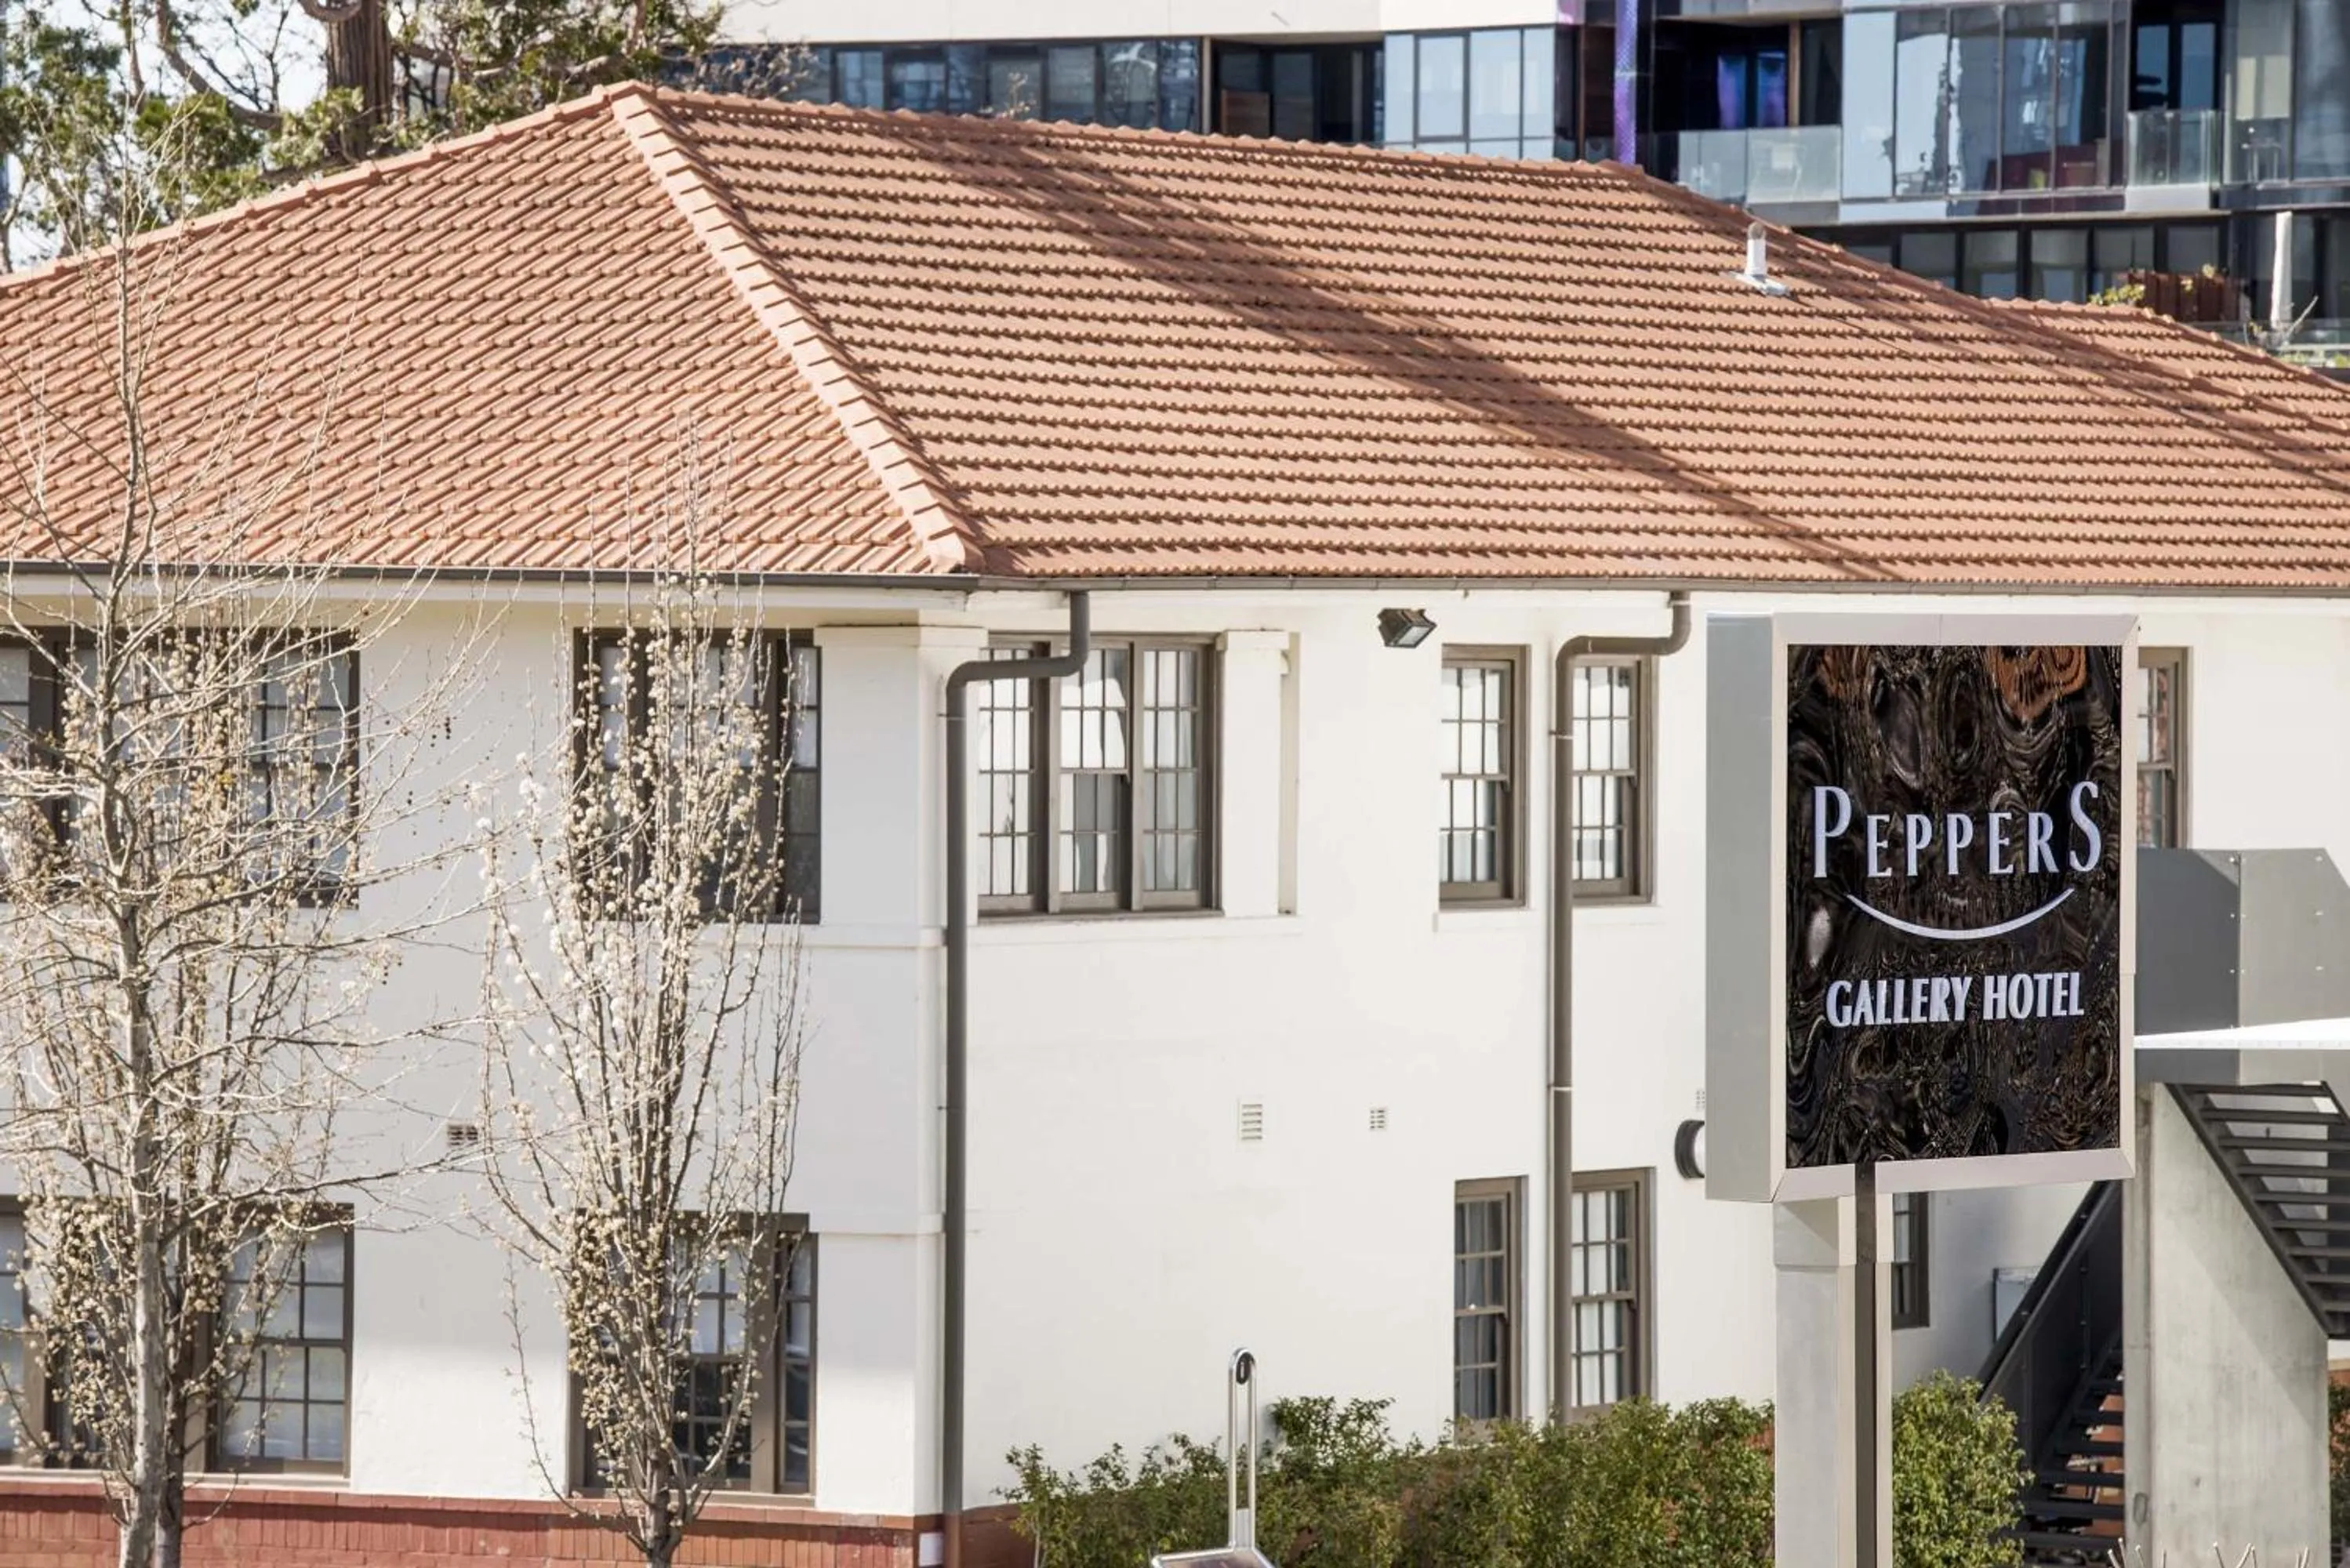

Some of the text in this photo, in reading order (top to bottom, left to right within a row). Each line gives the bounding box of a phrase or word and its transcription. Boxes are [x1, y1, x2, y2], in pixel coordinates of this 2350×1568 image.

[1814, 781, 2101, 878] PEPPERS
[1825, 971, 2085, 1028] GALLERY HOTEL
